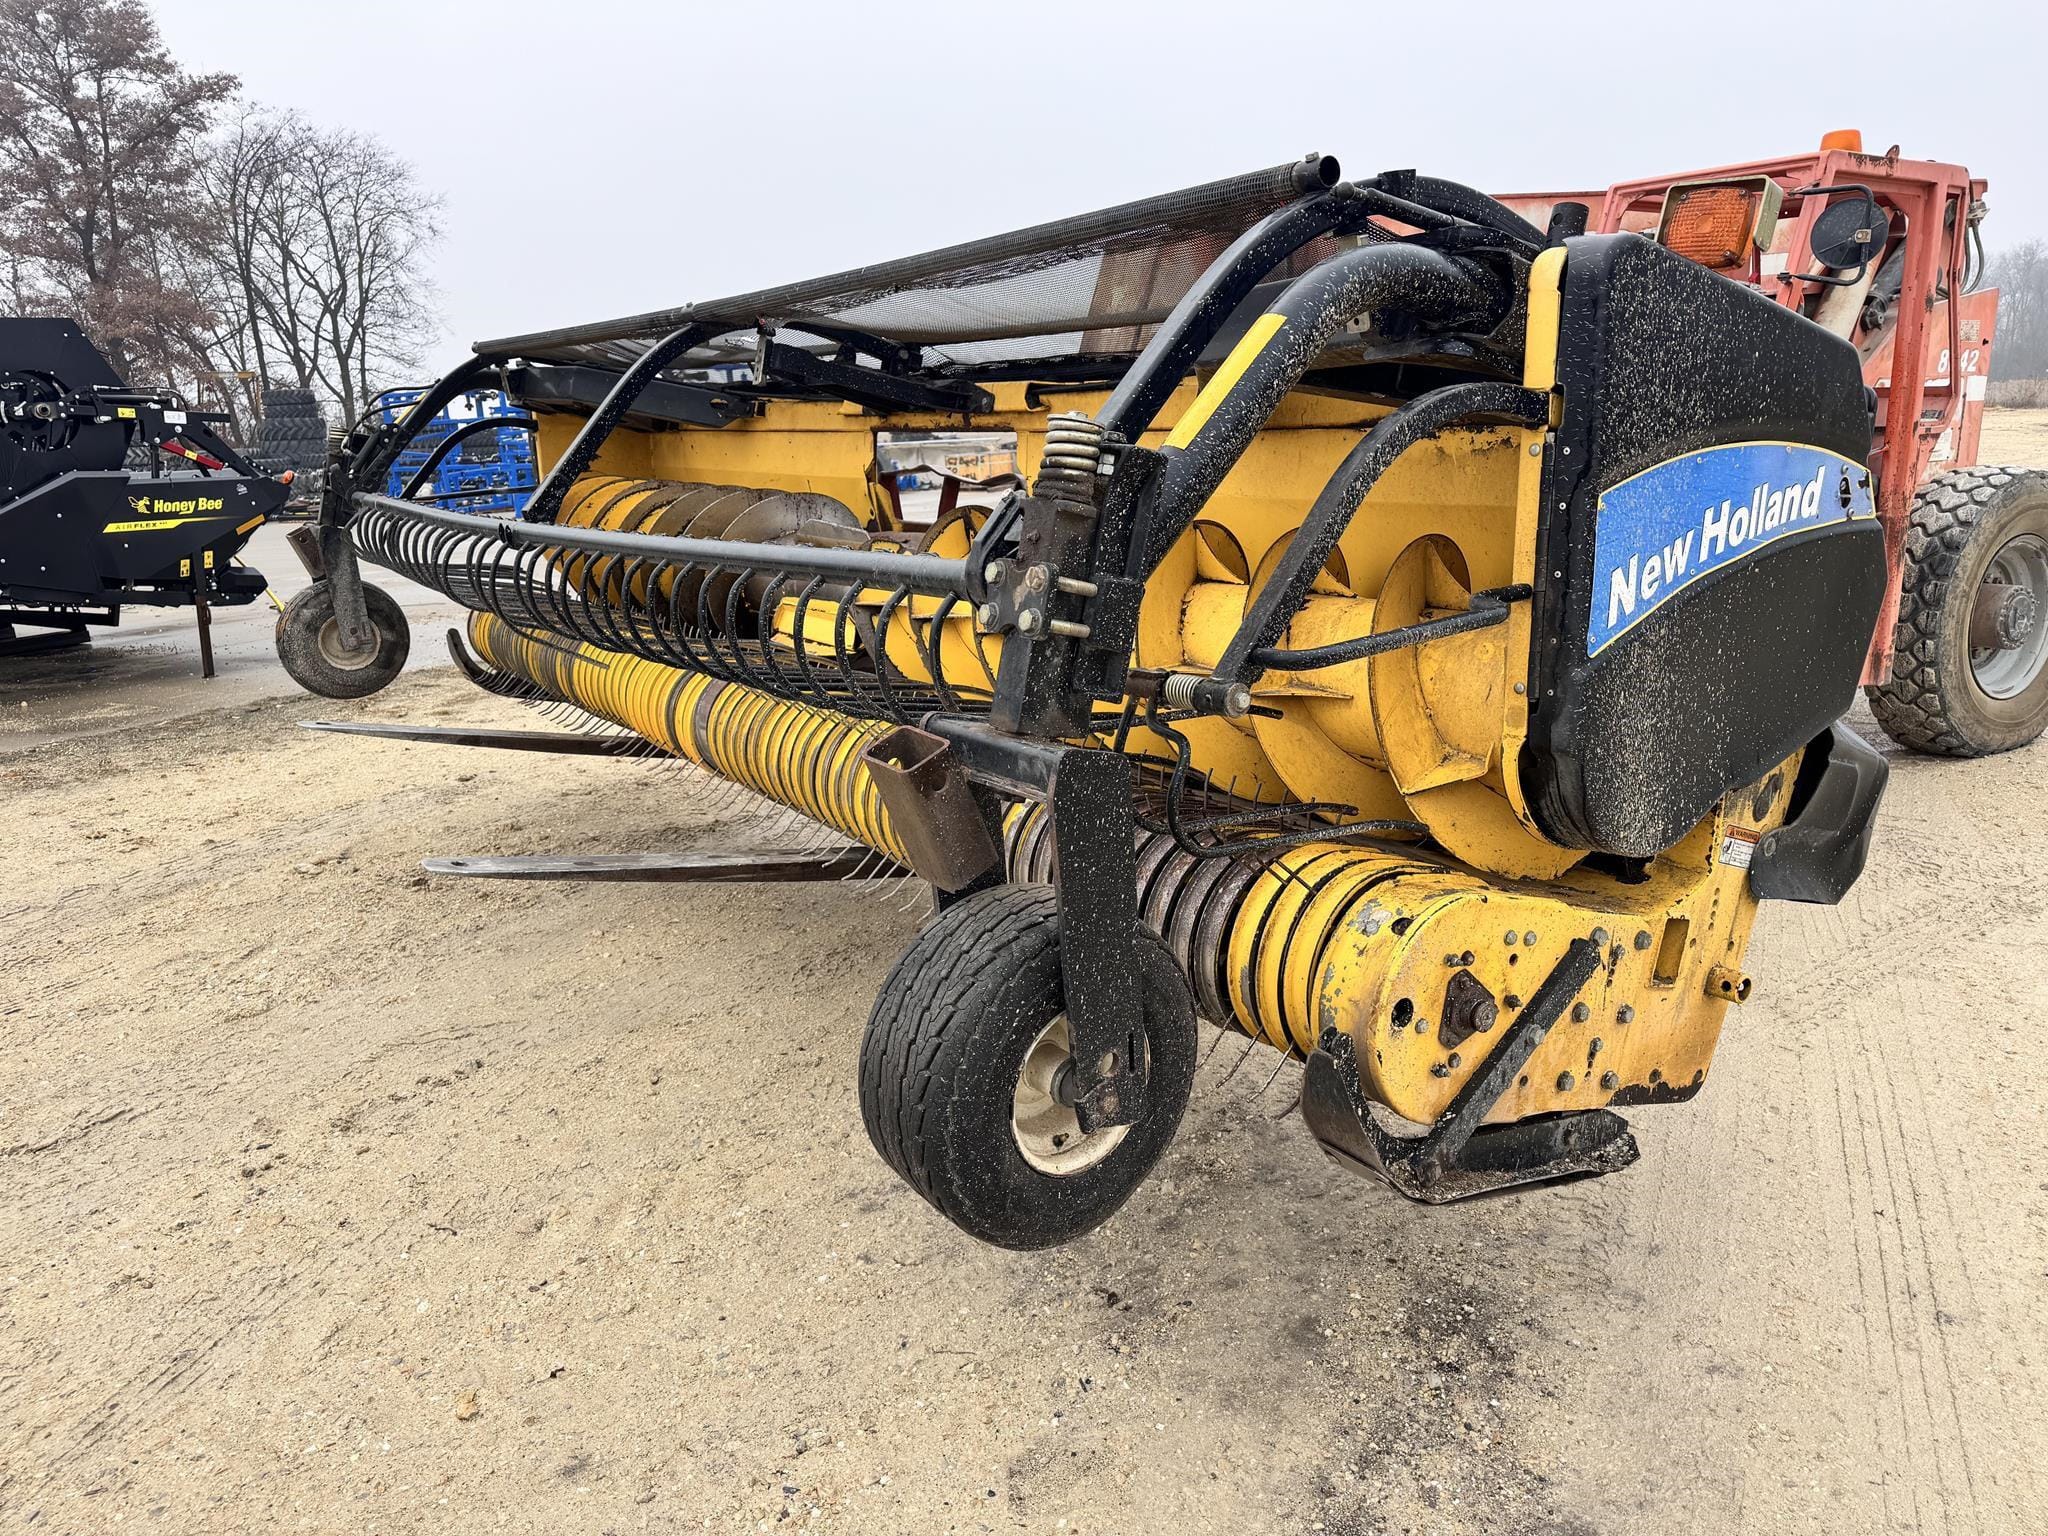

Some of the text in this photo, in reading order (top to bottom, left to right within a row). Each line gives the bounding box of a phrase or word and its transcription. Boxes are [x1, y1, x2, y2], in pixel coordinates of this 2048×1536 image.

[1937, 347, 1981, 374] 842
[154, 498, 223, 514] Honey Bee
[1607, 465, 1825, 629] New Holland
